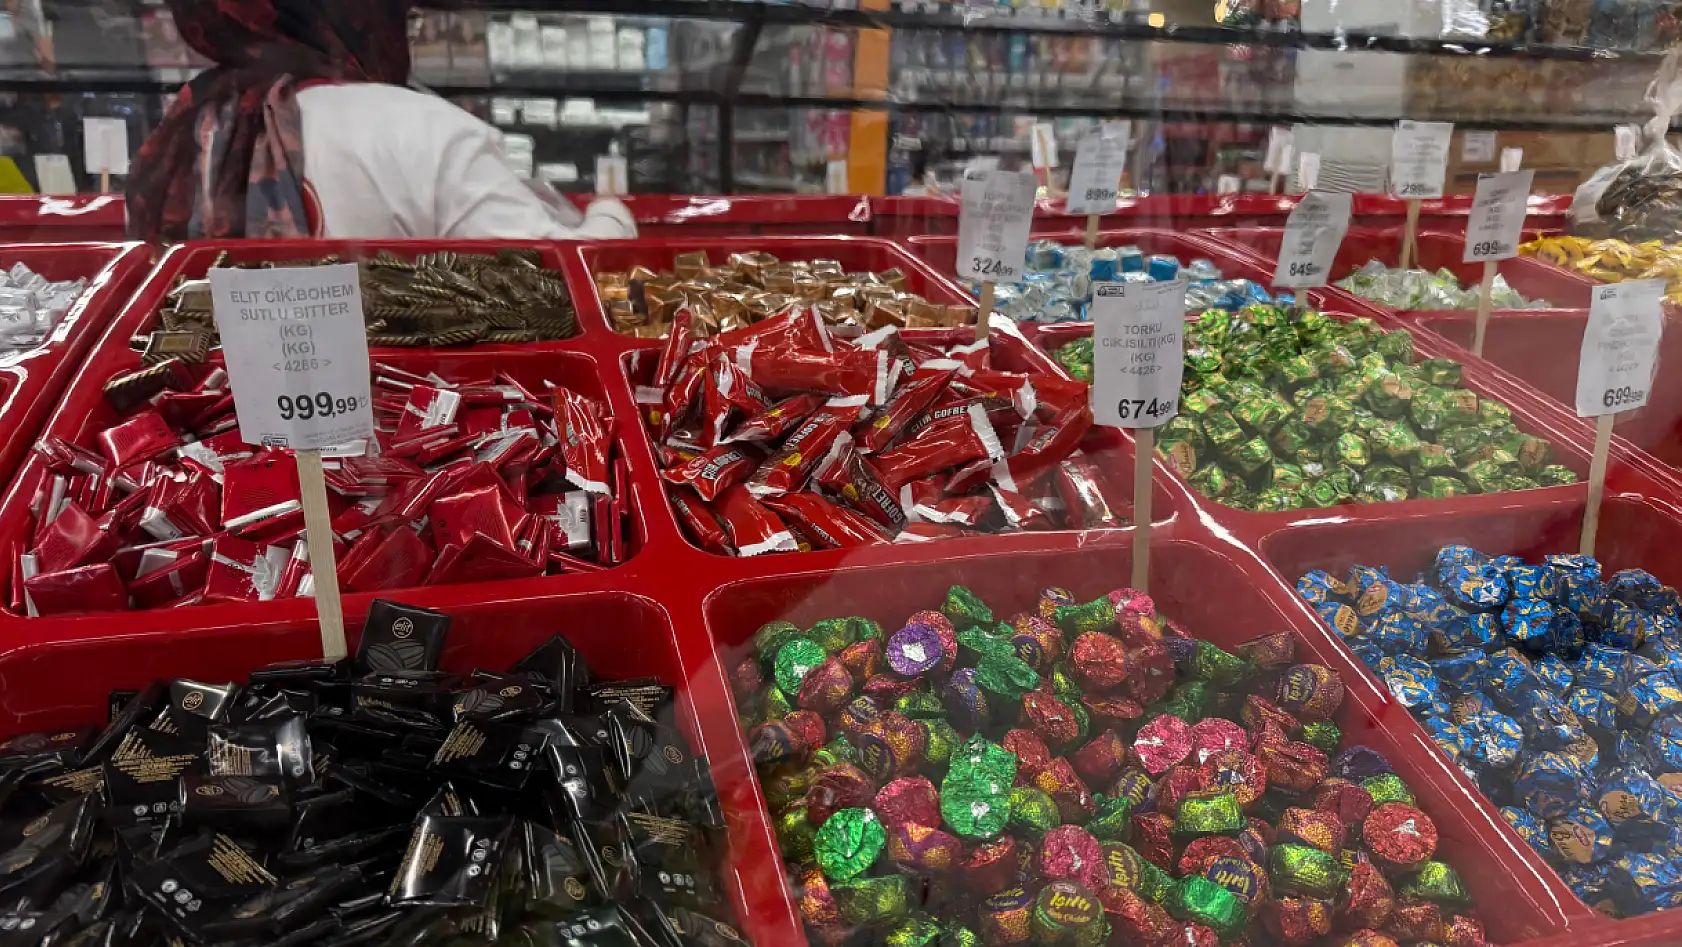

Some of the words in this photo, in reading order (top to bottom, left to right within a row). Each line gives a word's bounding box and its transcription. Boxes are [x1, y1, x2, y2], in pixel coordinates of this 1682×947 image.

[230, 289, 261, 303] ELIT
[293, 301, 350, 320] BITTER
[278, 324, 314, 341] (KG)
[281, 341, 317, 357] (KG)
[1129, 351, 1156, 365] (KG)
[934, 405, 968, 419] GOFRE
